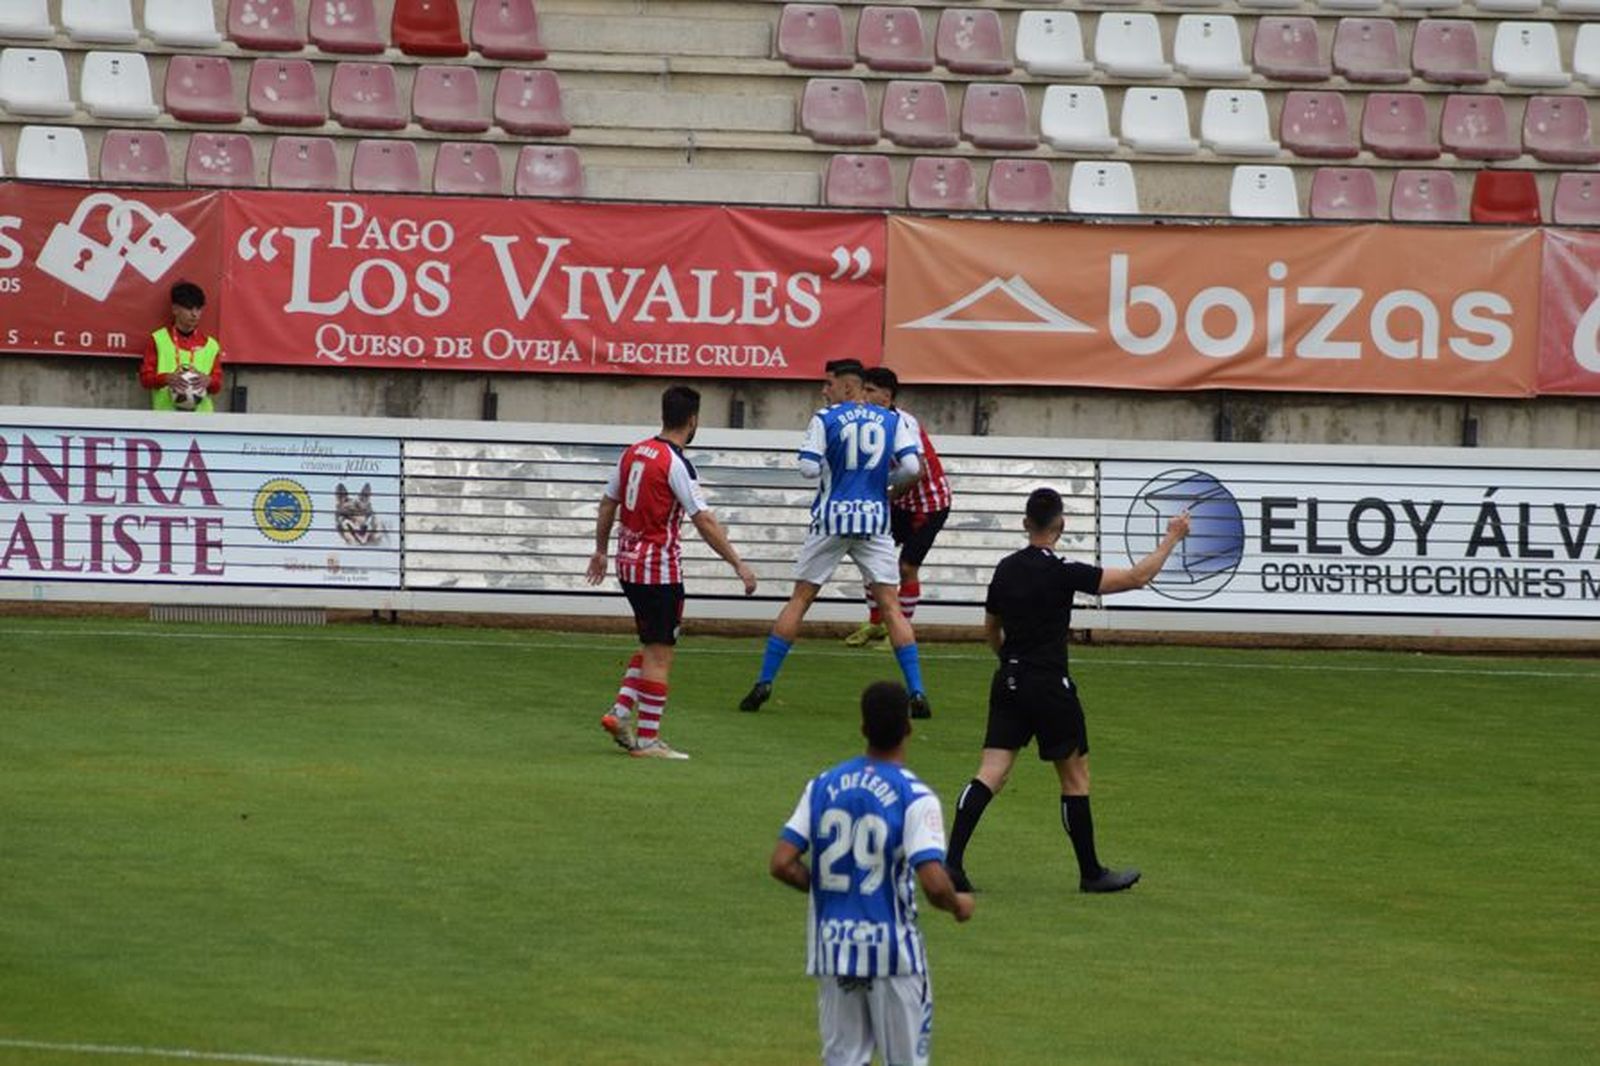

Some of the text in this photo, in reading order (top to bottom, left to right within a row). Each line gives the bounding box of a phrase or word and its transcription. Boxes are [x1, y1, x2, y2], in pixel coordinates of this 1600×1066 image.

[326, 201, 454, 252] PAGO
[1108, 253, 1514, 361] boizas
[315, 323, 581, 365] QUESO DE OVEJA
[606, 341, 788, 368] LECHE CRUDA
[840, 422, 886, 471] 19
[625, 461, 645, 511] 8
[0, 511, 224, 576] ALISTE
[1261, 486, 1600, 560] ELOY ÁLV
[1261, 562, 1565, 599] CONSTRUCCIONES
[819, 808, 888, 895] 29
